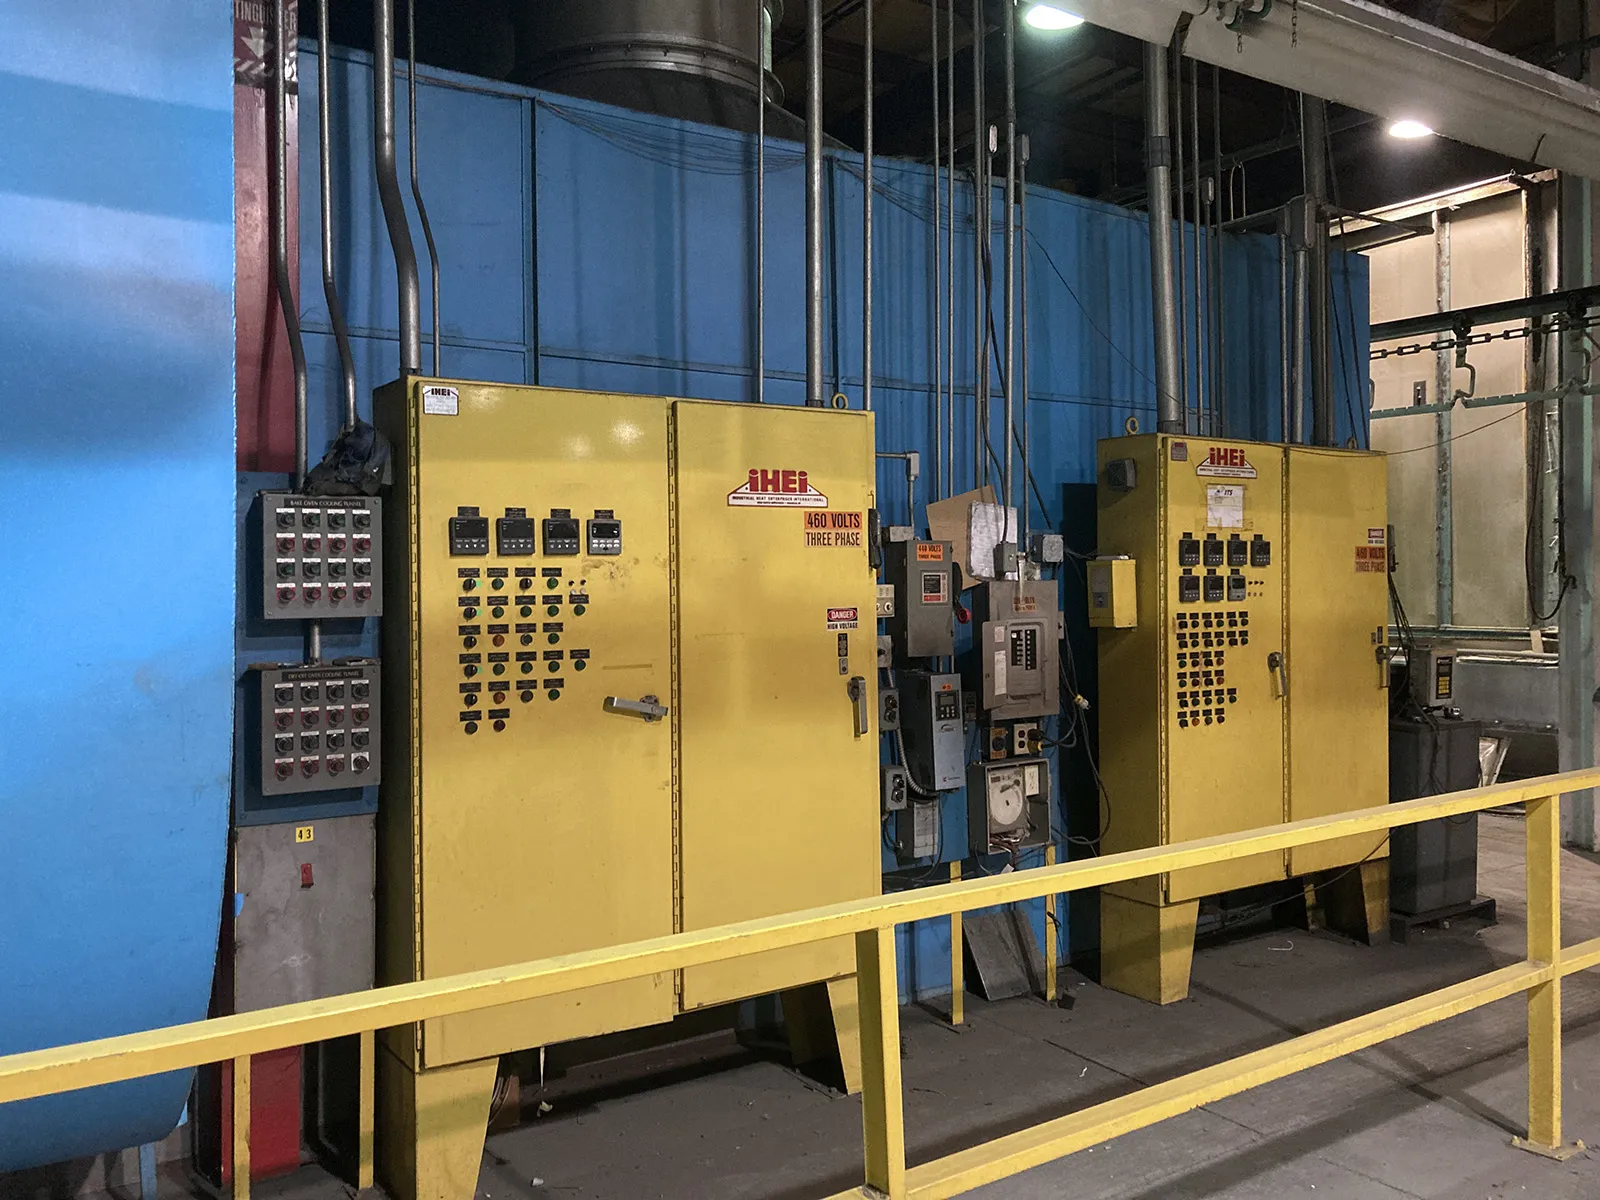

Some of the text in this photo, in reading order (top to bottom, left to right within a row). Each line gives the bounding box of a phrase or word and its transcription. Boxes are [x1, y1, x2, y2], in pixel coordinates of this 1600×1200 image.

[807, 513, 860, 528] 460 VOLTS
[806, 532, 860, 546] THREE PHASE
[928, 544, 942, 552] VOLTS
[830, 610, 854, 619] DANGER
[827, 622, 858, 630] HIGH VOLTAGE
